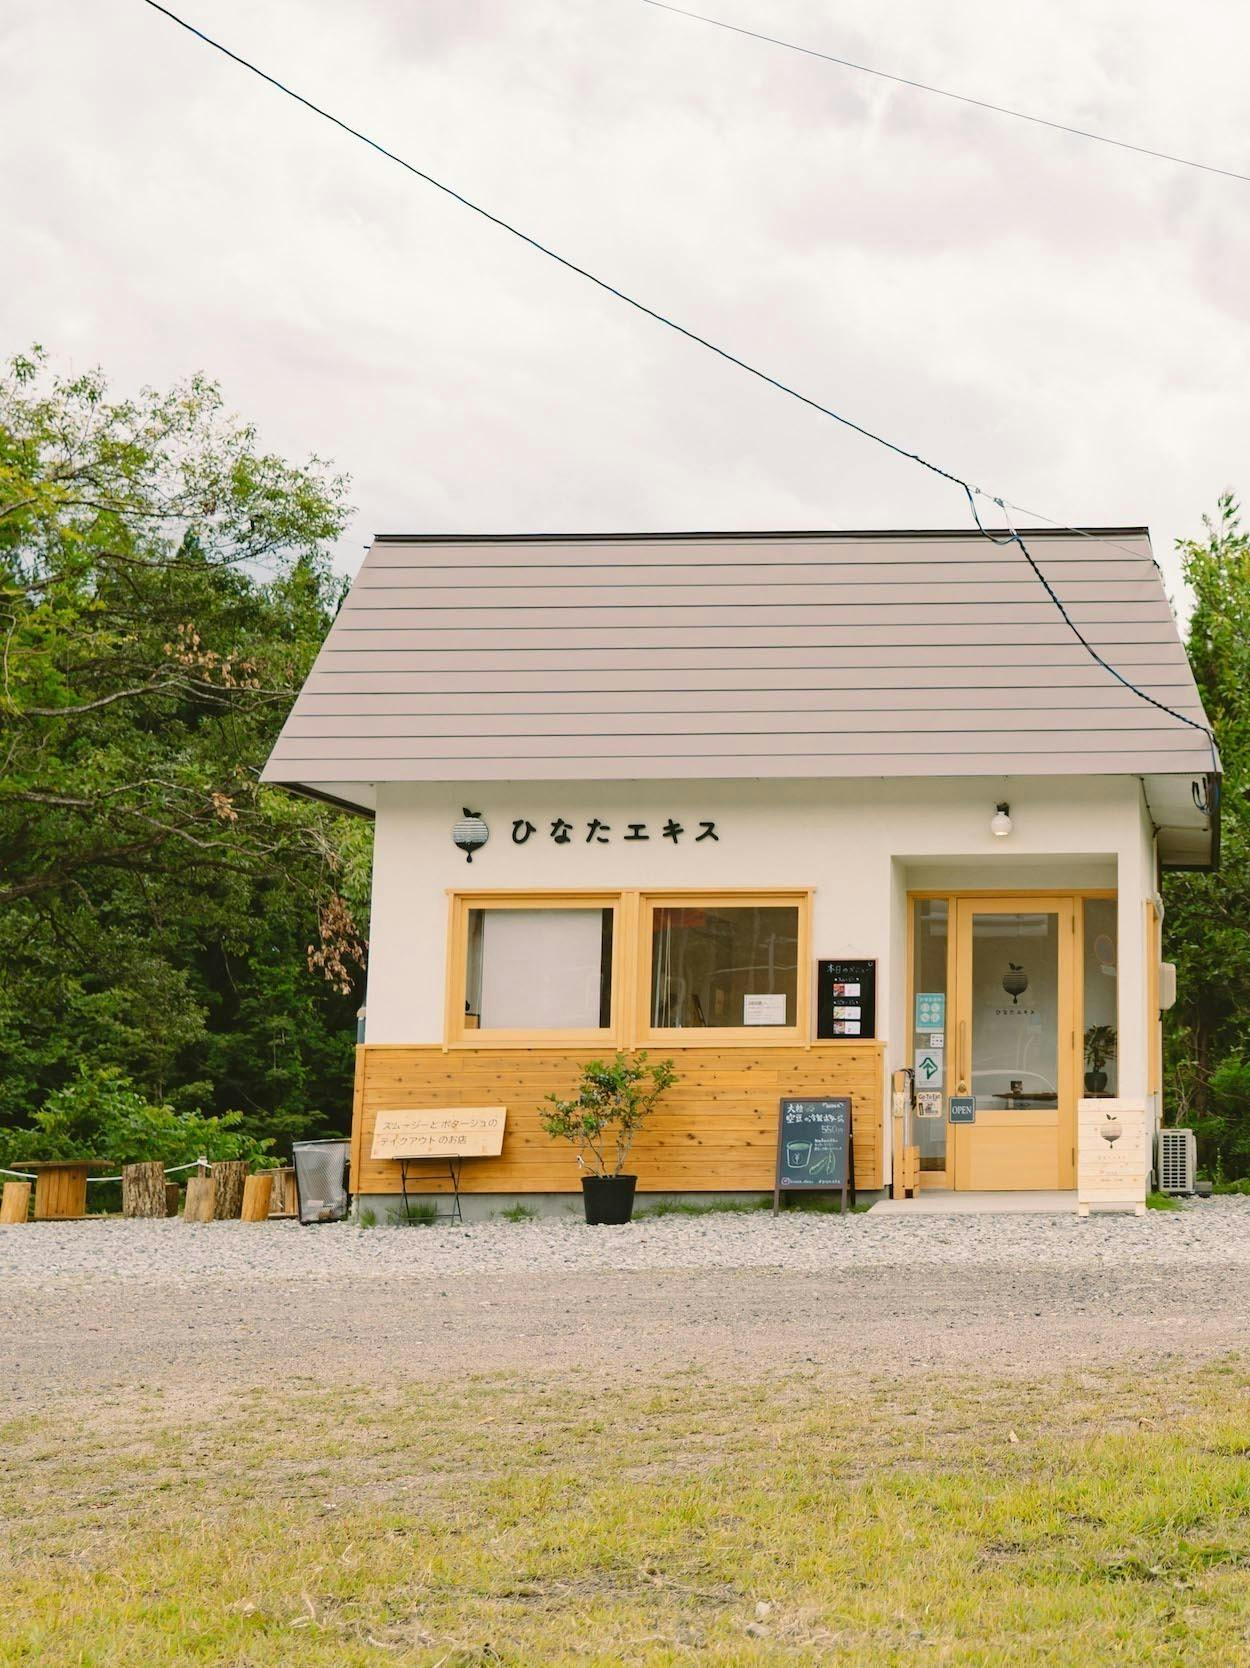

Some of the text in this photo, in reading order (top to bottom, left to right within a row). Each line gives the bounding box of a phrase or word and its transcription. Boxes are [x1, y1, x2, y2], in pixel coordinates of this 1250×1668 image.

[511, 818, 719, 844] ひなたエキス
[951, 1105, 973, 1115] OPEN
